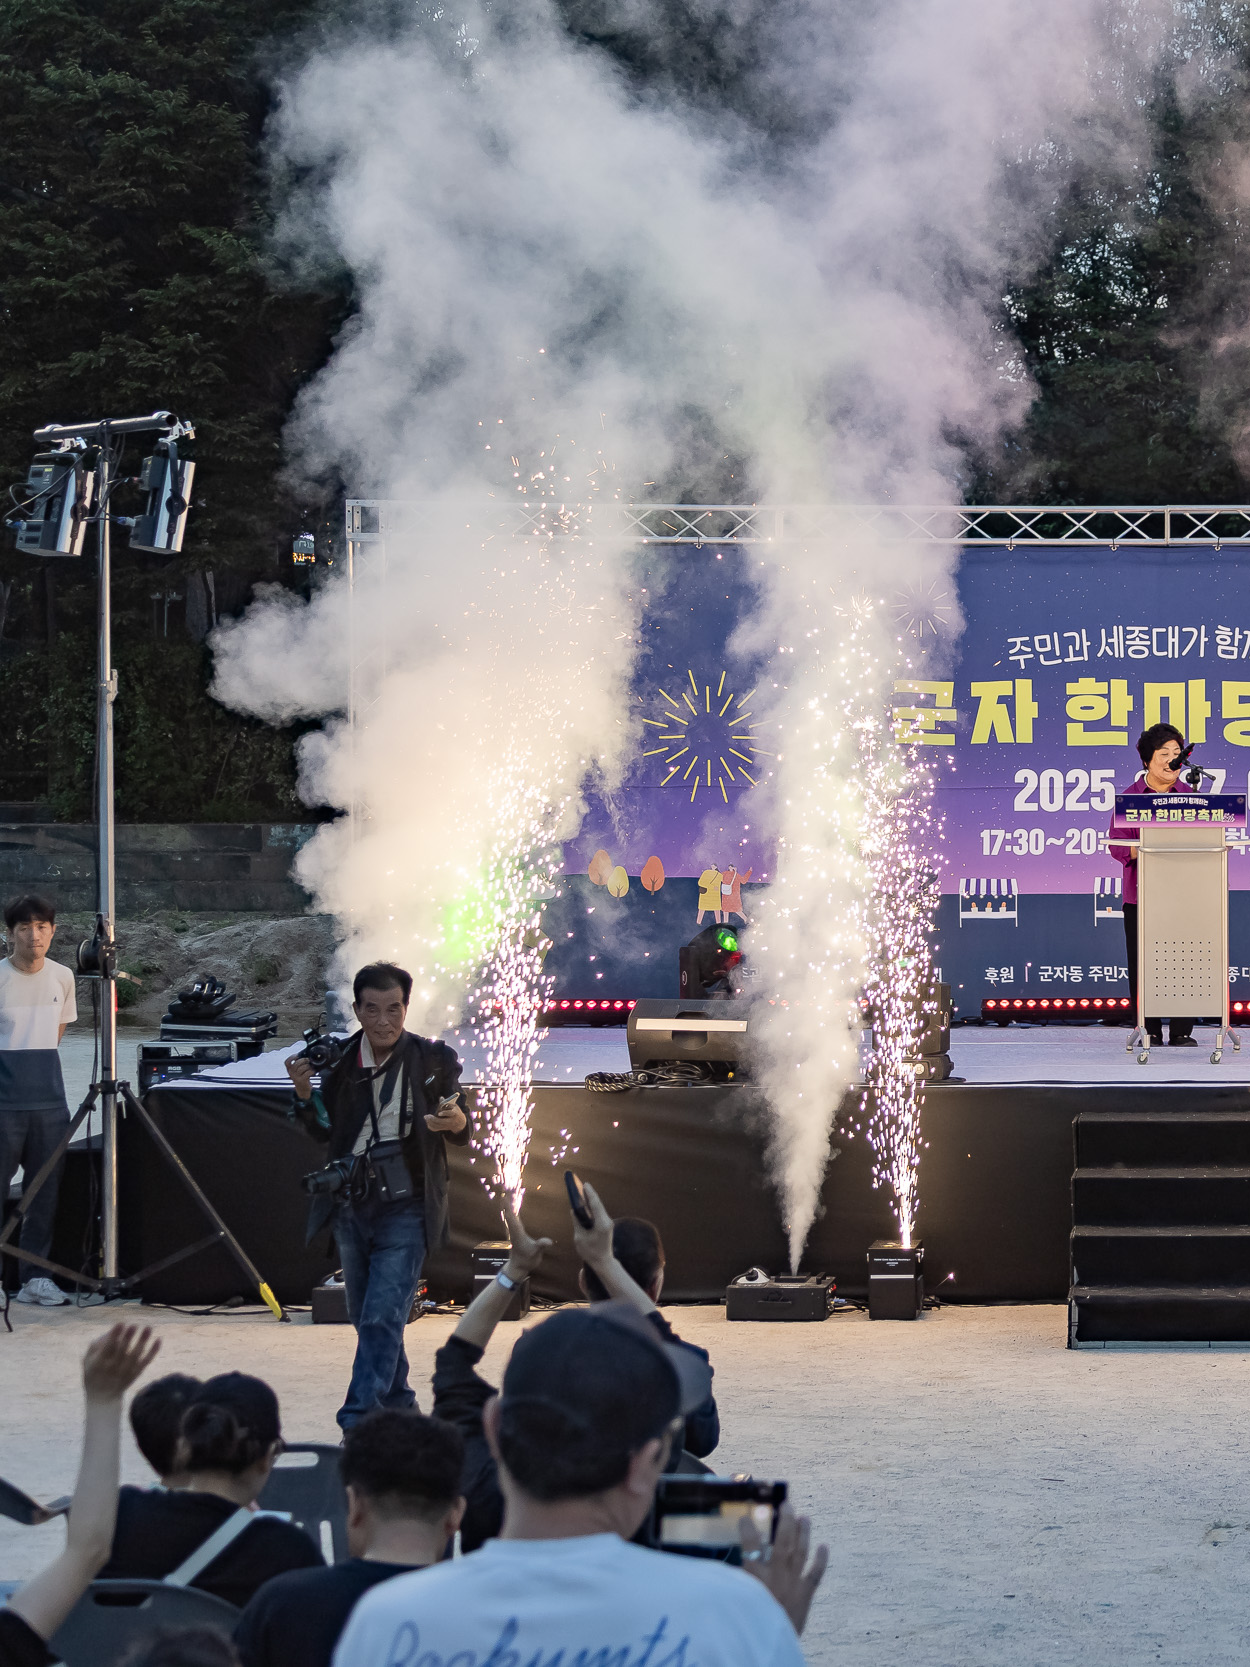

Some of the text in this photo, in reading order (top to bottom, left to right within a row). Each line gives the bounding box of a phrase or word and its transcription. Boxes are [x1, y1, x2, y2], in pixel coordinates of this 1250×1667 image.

[1007, 629, 1091, 669] 주민과
[1097, 624, 1209, 660] 세종대가
[891, 678, 1039, 746] 군자
[1125, 808, 1152, 822] 군자
[1155, 808, 1224, 822] 한마당축제
[984, 965, 1014, 984] 후원
[1038, 965, 1084, 982] 군자동
